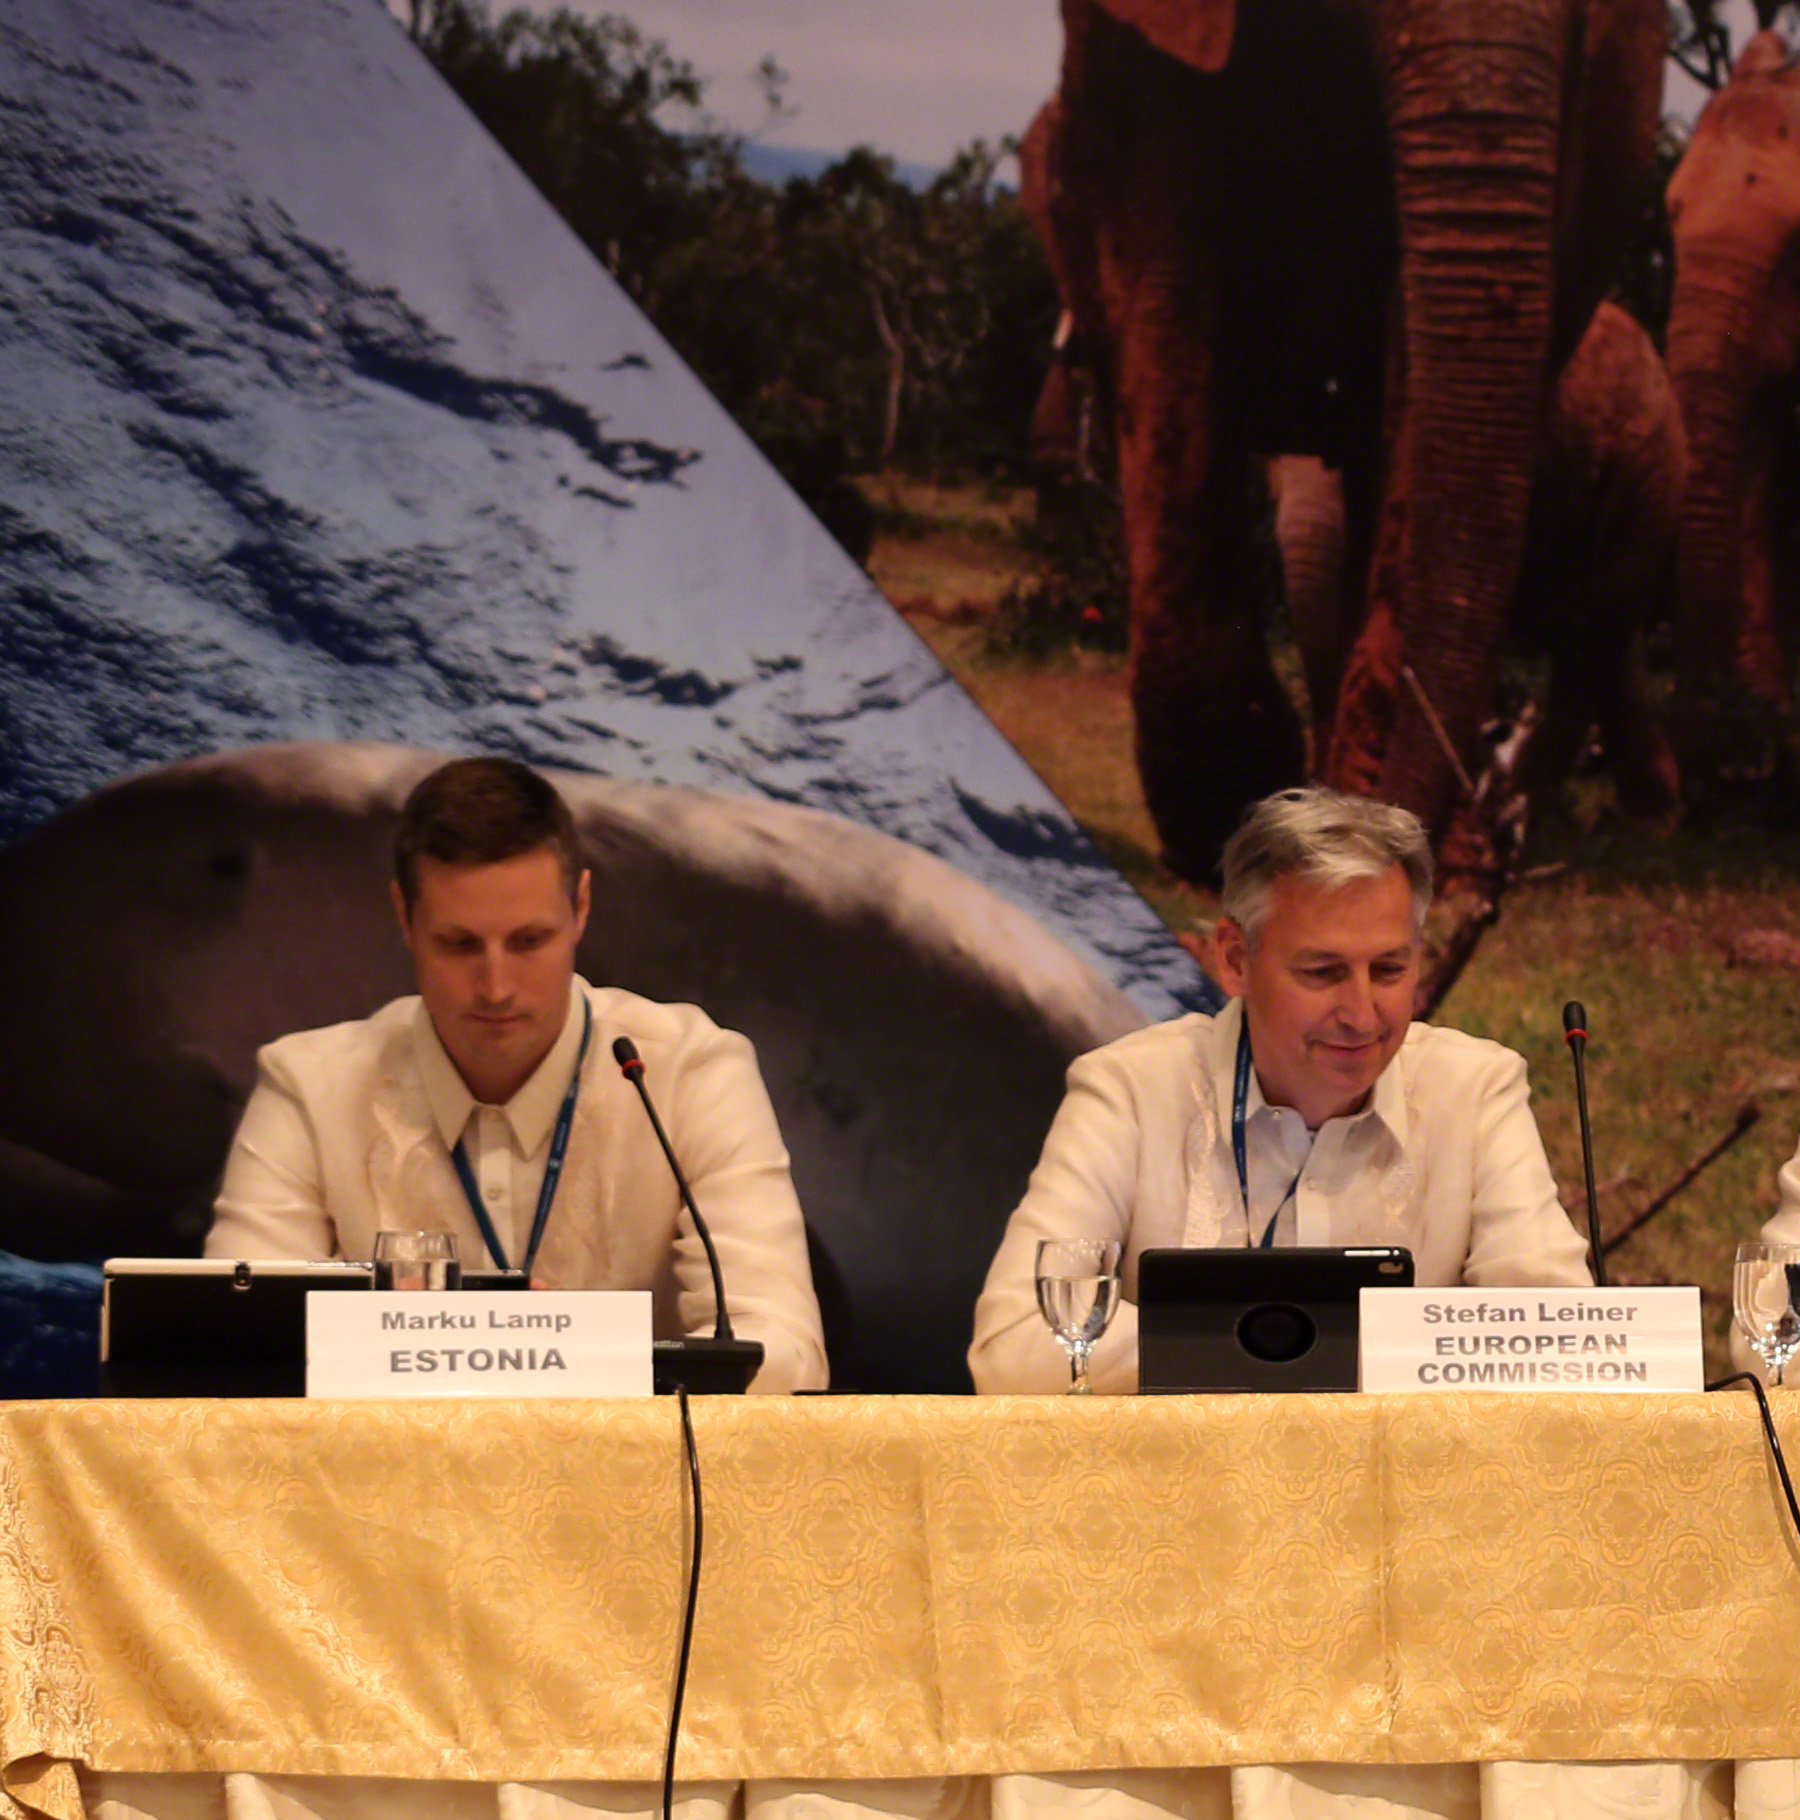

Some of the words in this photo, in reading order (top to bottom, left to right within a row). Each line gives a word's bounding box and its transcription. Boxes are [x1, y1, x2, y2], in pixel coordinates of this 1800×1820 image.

[381, 1310, 477, 1331] Marku
[488, 1310, 573, 1334] Lamp
[1423, 1303, 1526, 1323] Stefan
[1538, 1302, 1638, 1323] Leiner
[1435, 1334, 1628, 1356] EUROPEAN
[390, 1348, 567, 1374] ESTONIA
[1417, 1362, 1647, 1385] COMMISSION
